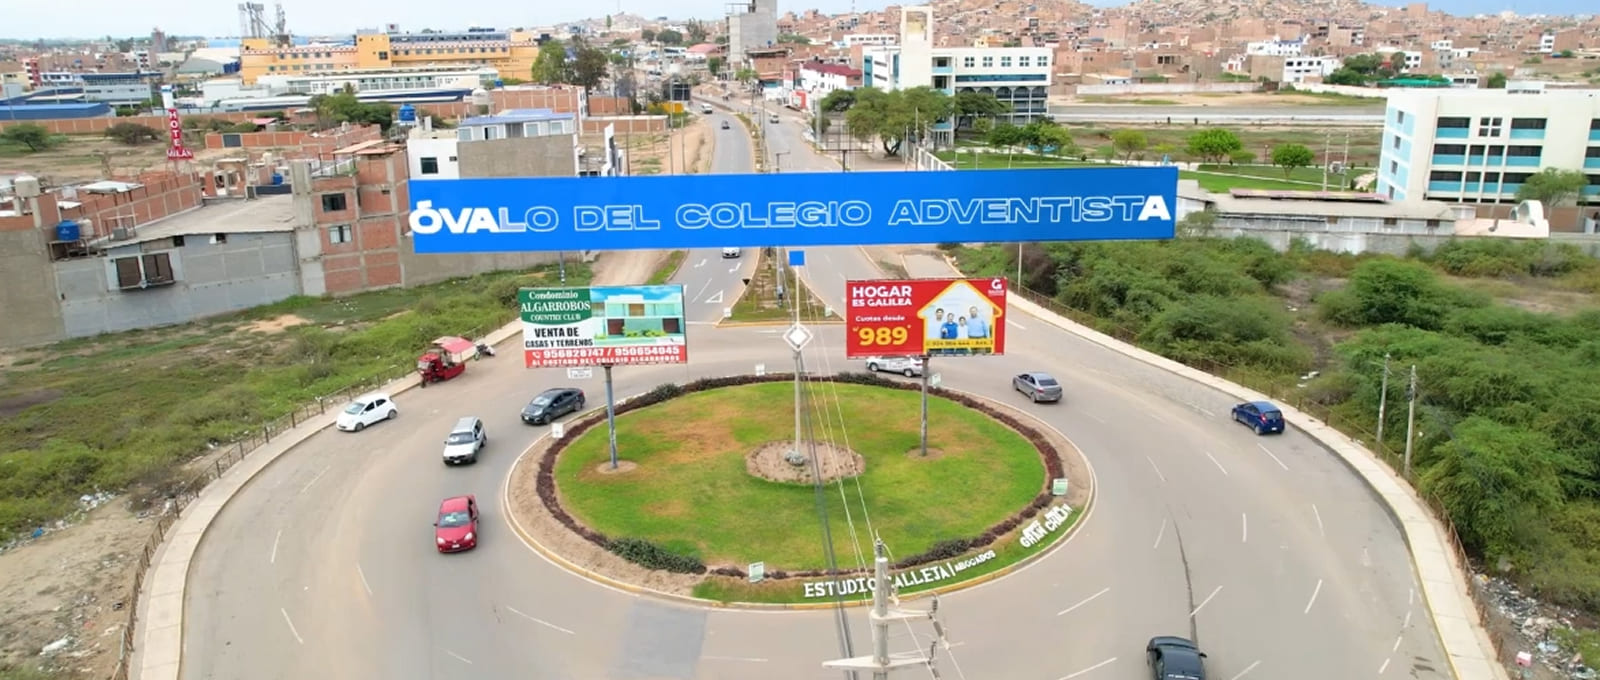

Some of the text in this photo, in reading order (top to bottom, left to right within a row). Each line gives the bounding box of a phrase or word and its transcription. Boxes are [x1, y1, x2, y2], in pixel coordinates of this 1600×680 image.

[528, 289, 579, 300] Condominio
[852, 285, 912, 298] HOGAR
[520, 300, 591, 313] ALGARROBOS
[852, 298, 912, 307] ES GALILEA
[530, 313, 581, 321] COUNTRY CLUB
[534, 327, 580, 338] VENTA DE
[525, 340, 548, 348] CASAS
[556, 338, 593, 347] TERRENOS
[886, 565, 951, 589] ALLEJA
[954, 550, 996, 573] ABOGADOS
